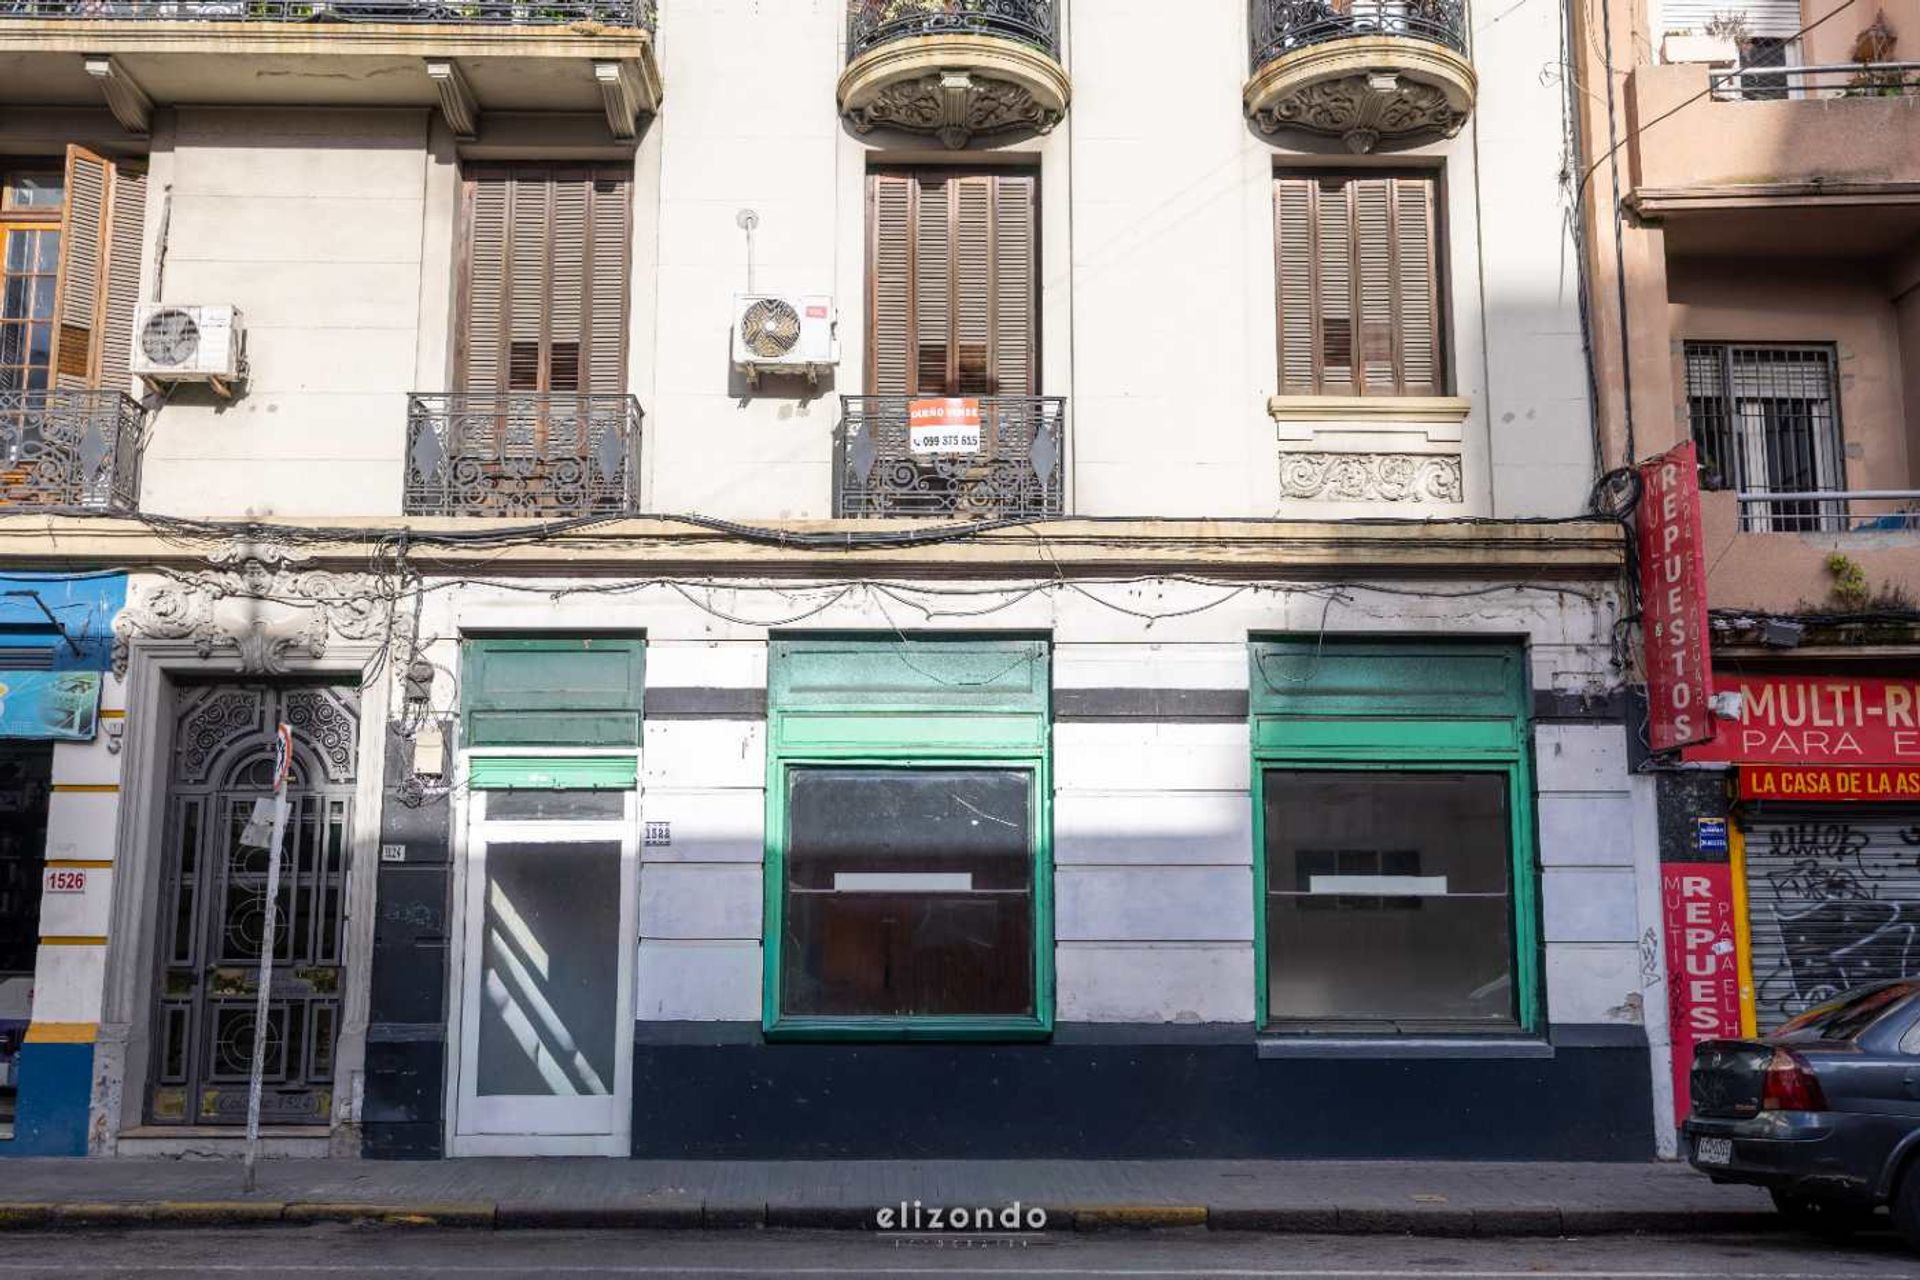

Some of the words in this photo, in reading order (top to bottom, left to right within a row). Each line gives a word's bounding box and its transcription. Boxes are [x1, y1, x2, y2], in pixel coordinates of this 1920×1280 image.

[923, 436, 940, 447] 099
[942, 435, 959, 446] 375
[961, 435, 978, 446] 615
[1662, 463, 1692, 741] REPUESTOS
[1740, 683, 1920, 728] MULTI-R
[1742, 729, 1864, 756] PARA
[1751, 771, 1777, 794] LA
[1781, 771, 1830, 794] CASA
[1836, 772, 1862, 794] DE
[1867, 772, 1892, 794] LA
[49, 872, 84, 890] 1526
[1664, 876, 1681, 964] MULTI
[1718, 901, 1735, 971] PAA
[1723, 979, 1736, 1013] EL
